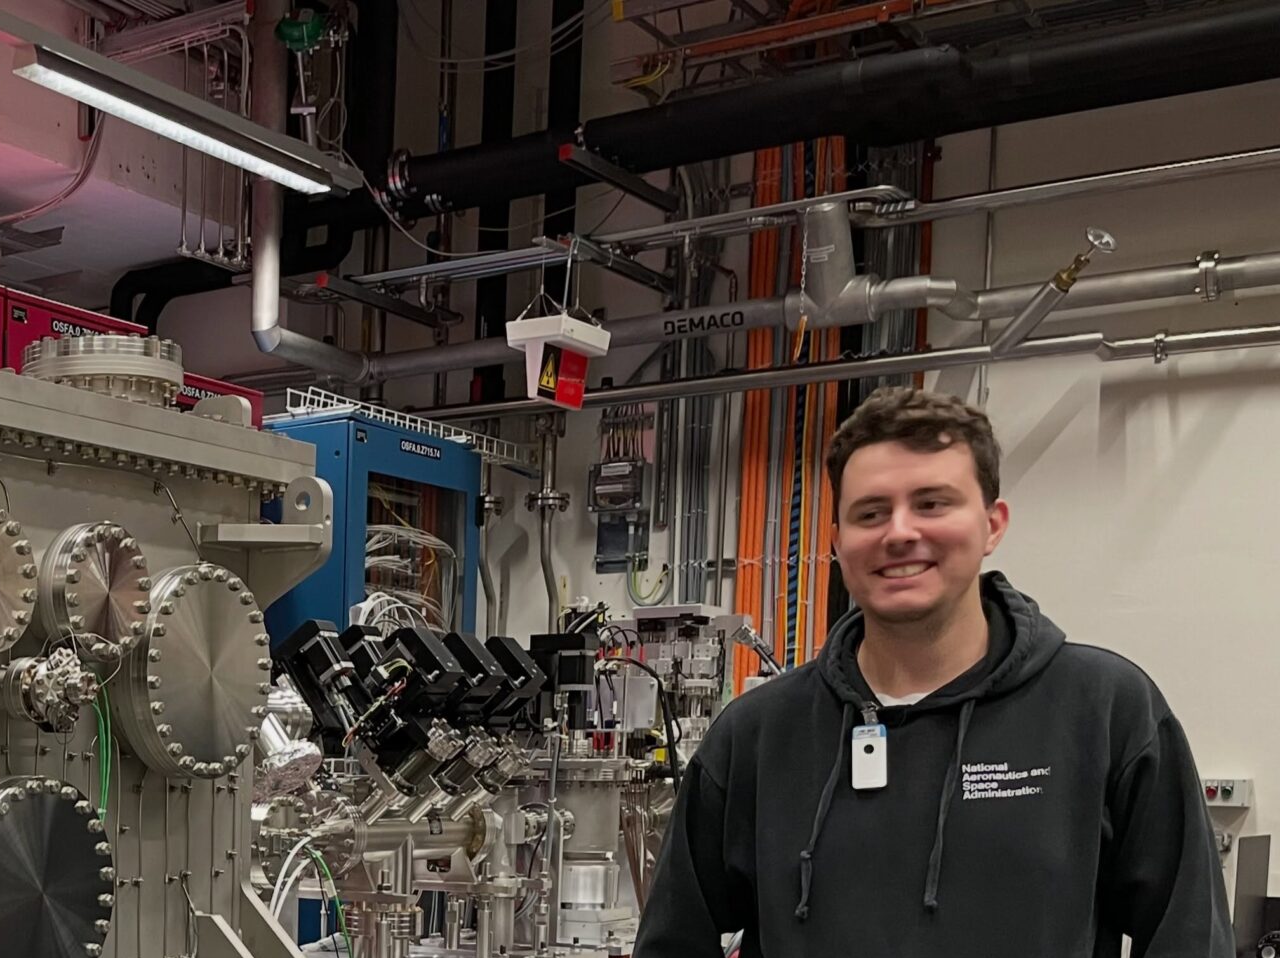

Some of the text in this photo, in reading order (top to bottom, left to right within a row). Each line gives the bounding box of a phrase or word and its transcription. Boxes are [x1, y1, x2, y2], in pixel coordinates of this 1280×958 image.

[663, 310, 745, 336] DEMACO
[961, 762, 1008, 773] National
[962, 766, 1051, 782] Aeronautics and
[962, 781, 999, 791] Space
[963, 786, 1043, 800] Administration
